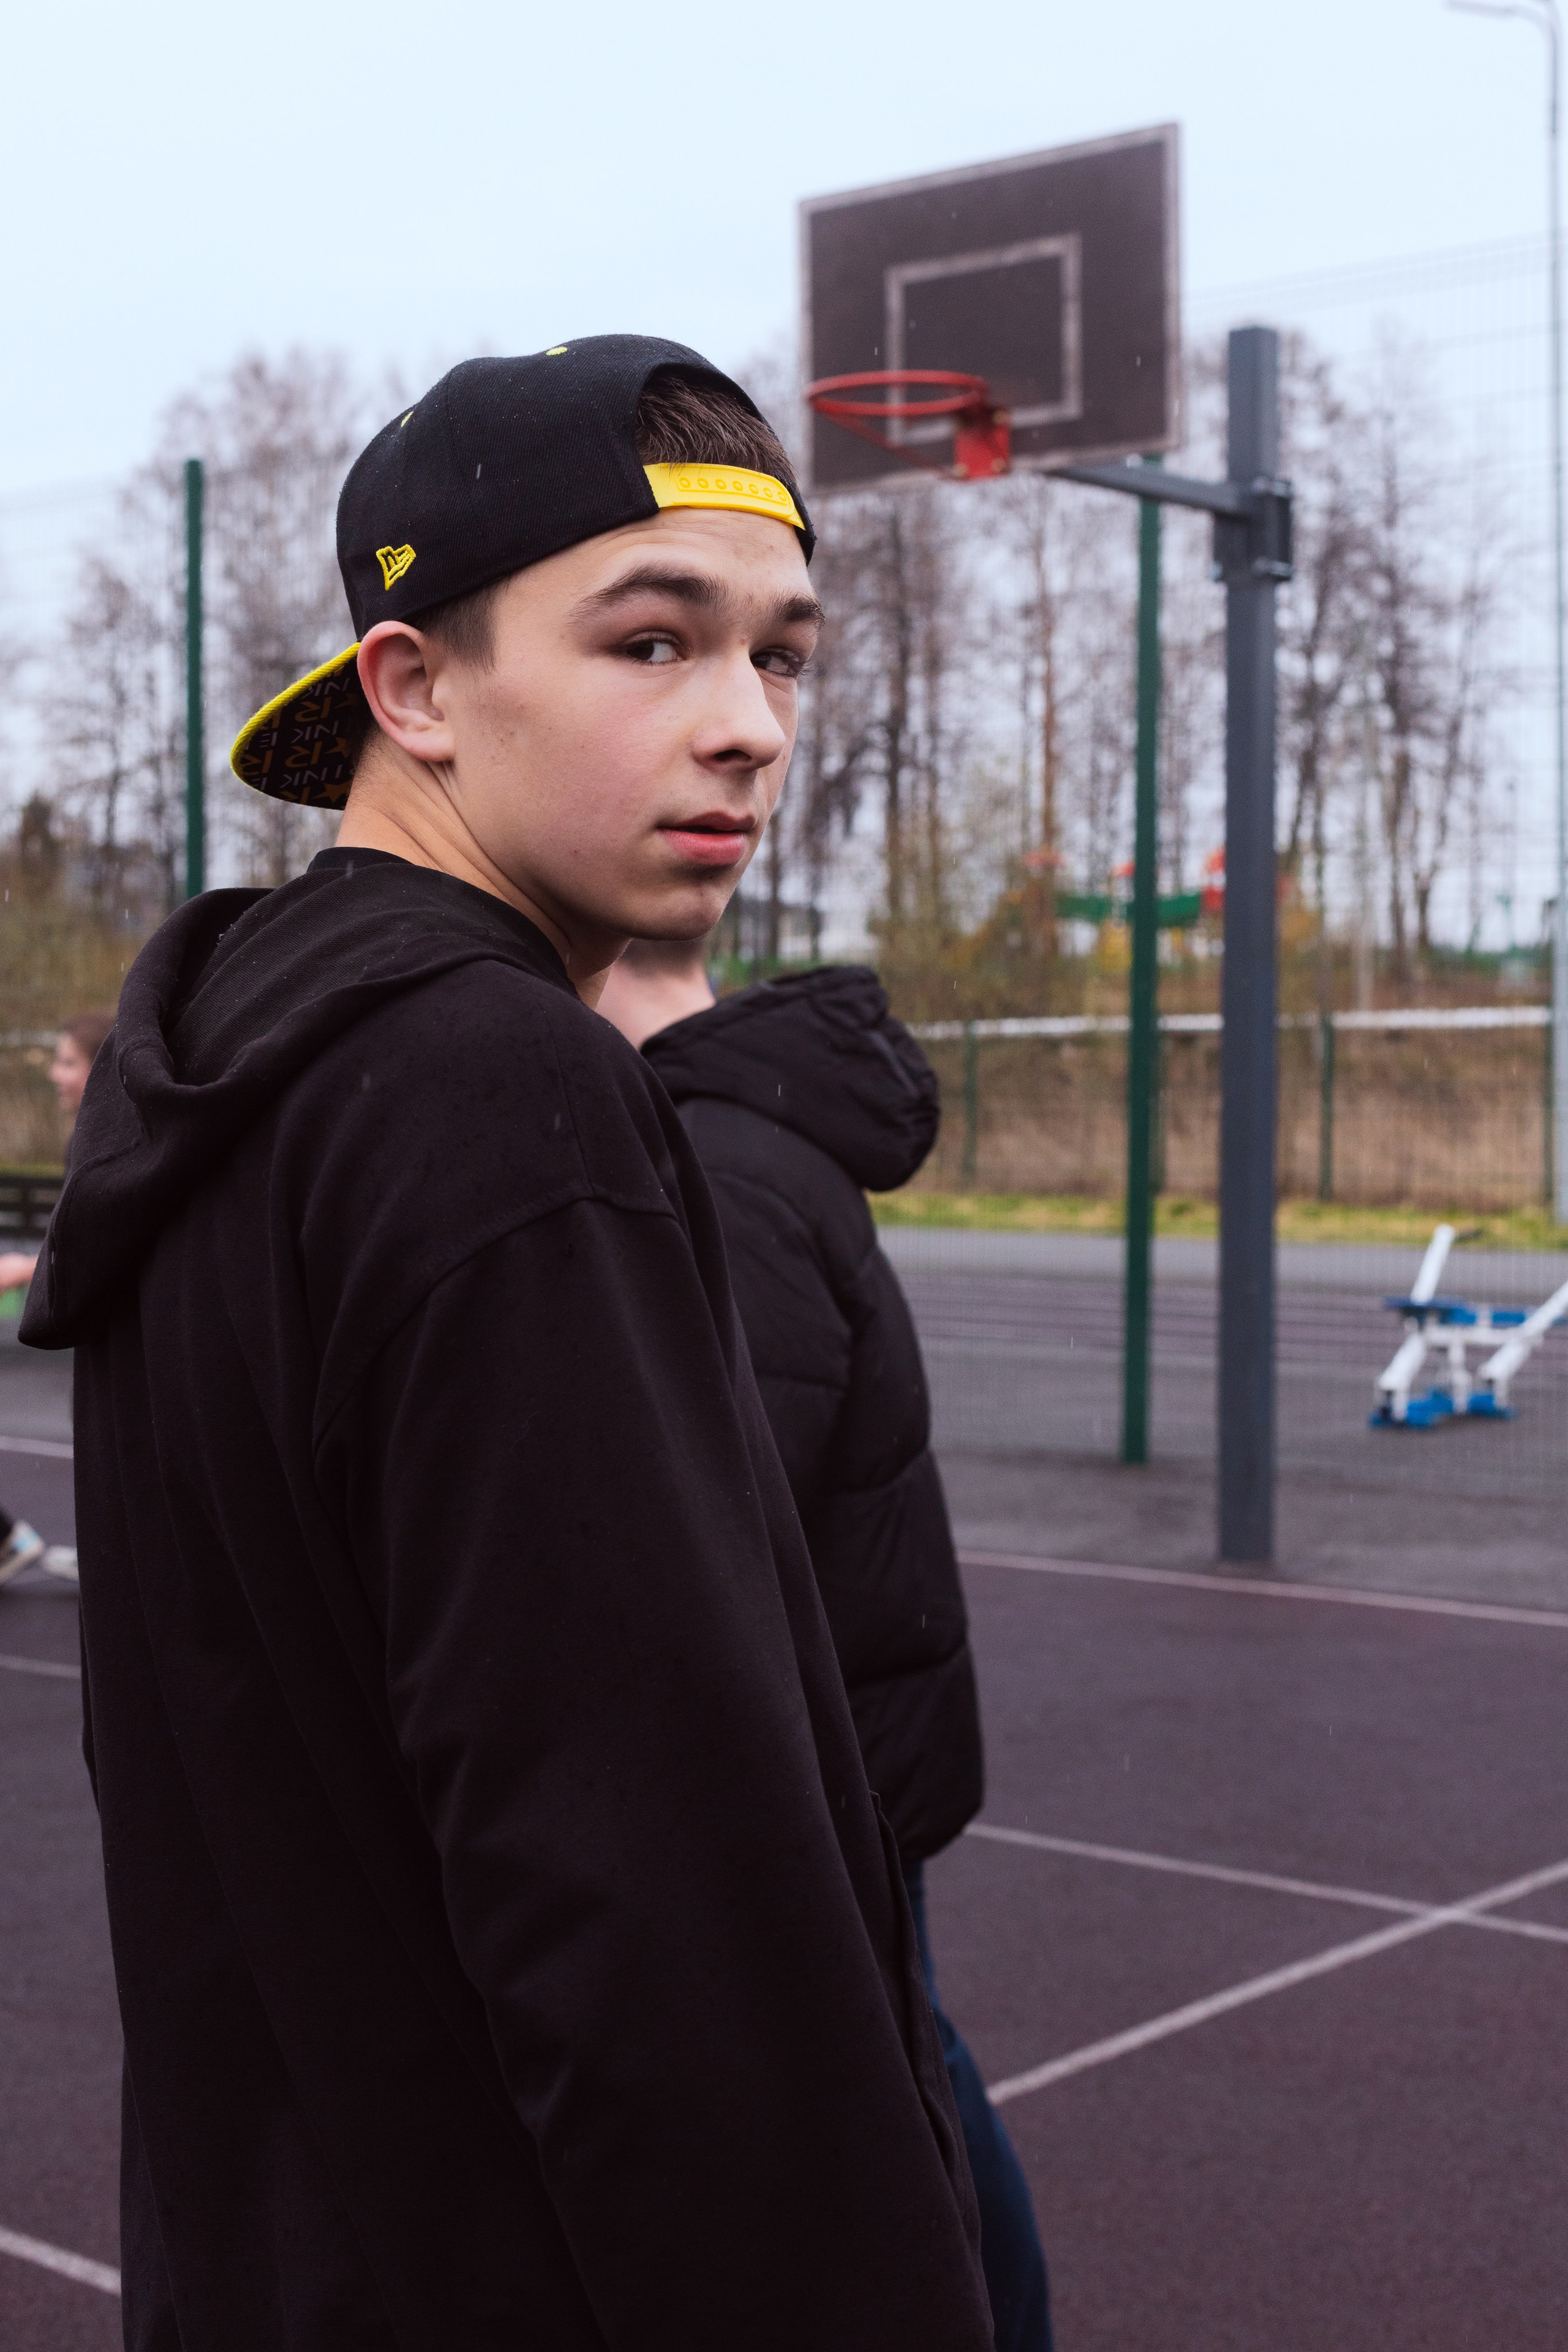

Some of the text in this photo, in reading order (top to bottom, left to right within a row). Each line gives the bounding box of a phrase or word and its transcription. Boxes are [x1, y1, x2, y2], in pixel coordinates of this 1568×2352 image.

[290, 720, 339, 744] NK
[285, 741, 322, 768] R
[279, 764, 342, 789] INK
